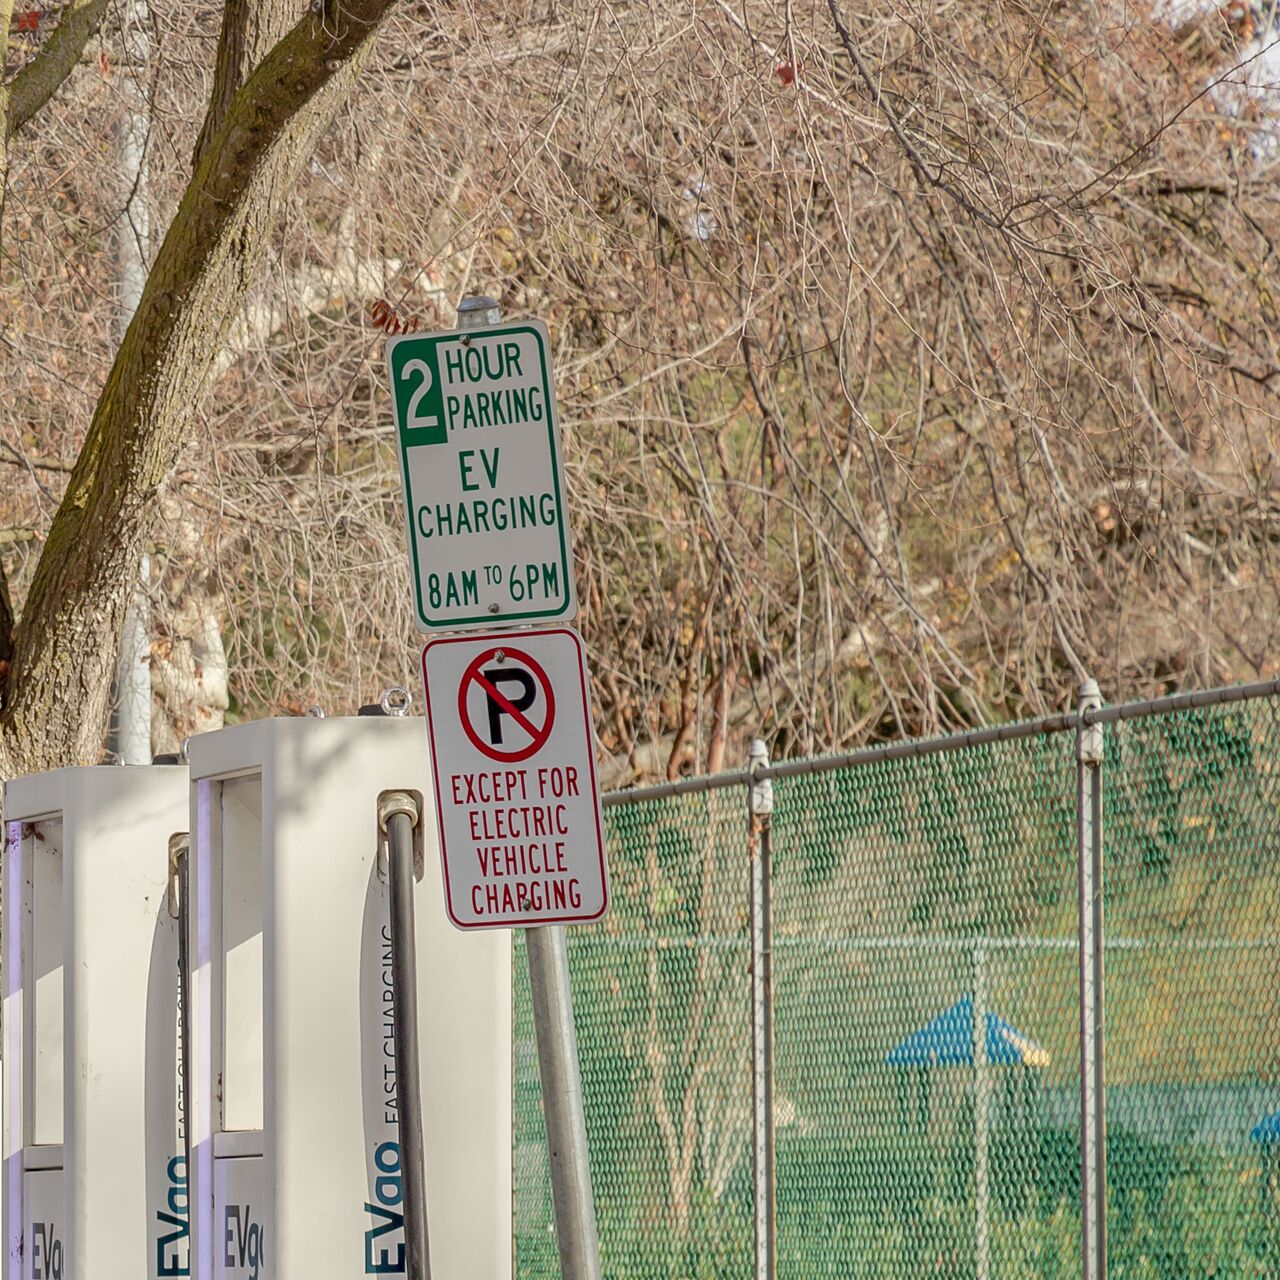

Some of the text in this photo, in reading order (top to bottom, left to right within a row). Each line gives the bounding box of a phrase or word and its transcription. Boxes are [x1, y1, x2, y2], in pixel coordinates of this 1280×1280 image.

[401, 342, 523, 429] 2 HOUR
[448, 386, 542, 430] PARKING
[459, 448, 500, 491] EV
[418, 493, 555, 538] CHARGING
[429, 562, 559, 608] 8AM TO 6PM
[452, 767, 579, 805] EXCEPT FOR
[470, 804, 567, 840] ELECTRIC
[477, 842, 567, 877] VEHICLE
[472, 878, 581, 914] CHARGING
